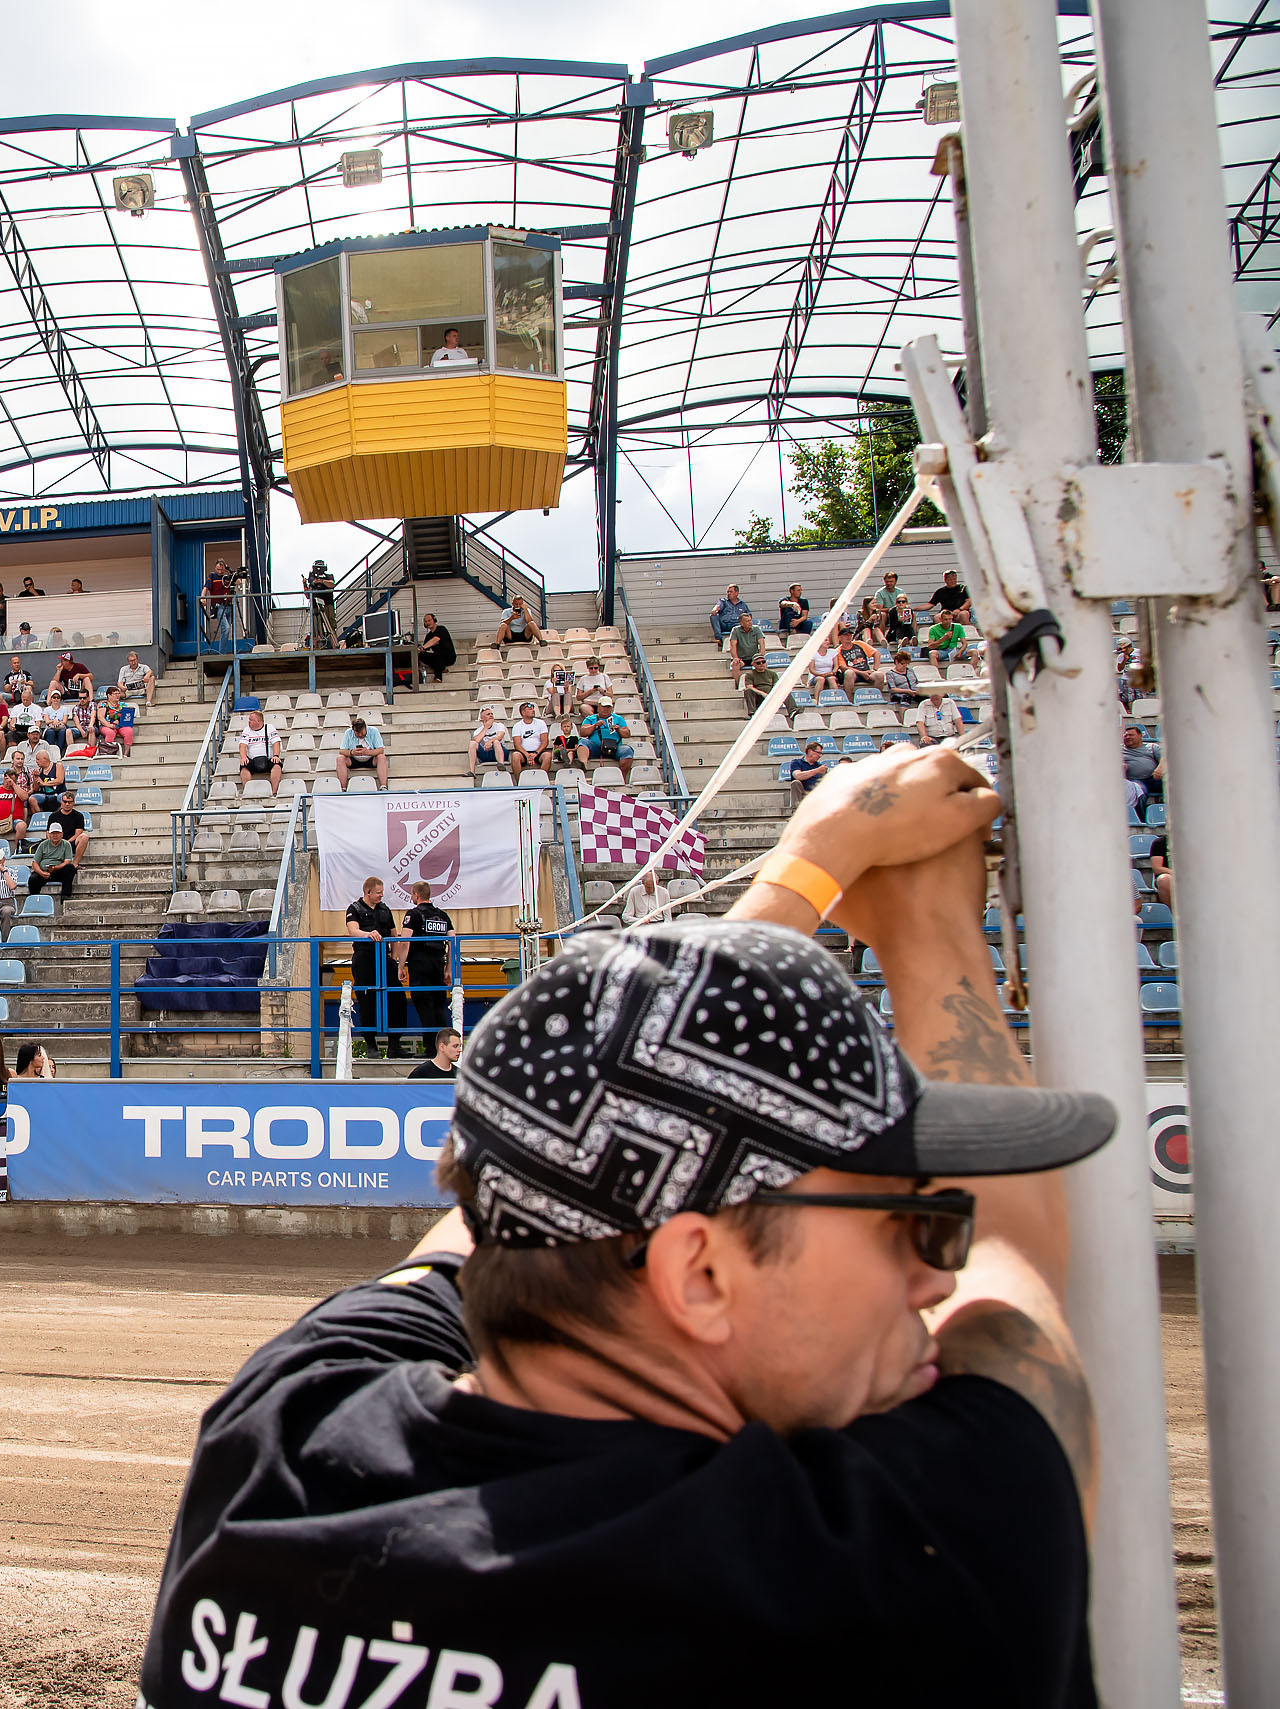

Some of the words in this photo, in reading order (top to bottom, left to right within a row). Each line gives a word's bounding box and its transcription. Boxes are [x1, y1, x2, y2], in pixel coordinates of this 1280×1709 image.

[387, 800, 461, 810] DAUGAVPILS
[392, 812, 456, 874] LOKOMOTIV
[441, 883, 462, 903] CLUB
[427, 922, 446, 932] GROM
[207, 1169, 247, 1187] CAR
[251, 1171, 312, 1189] PARTS
[317, 1172, 389, 1190] ONLINE
